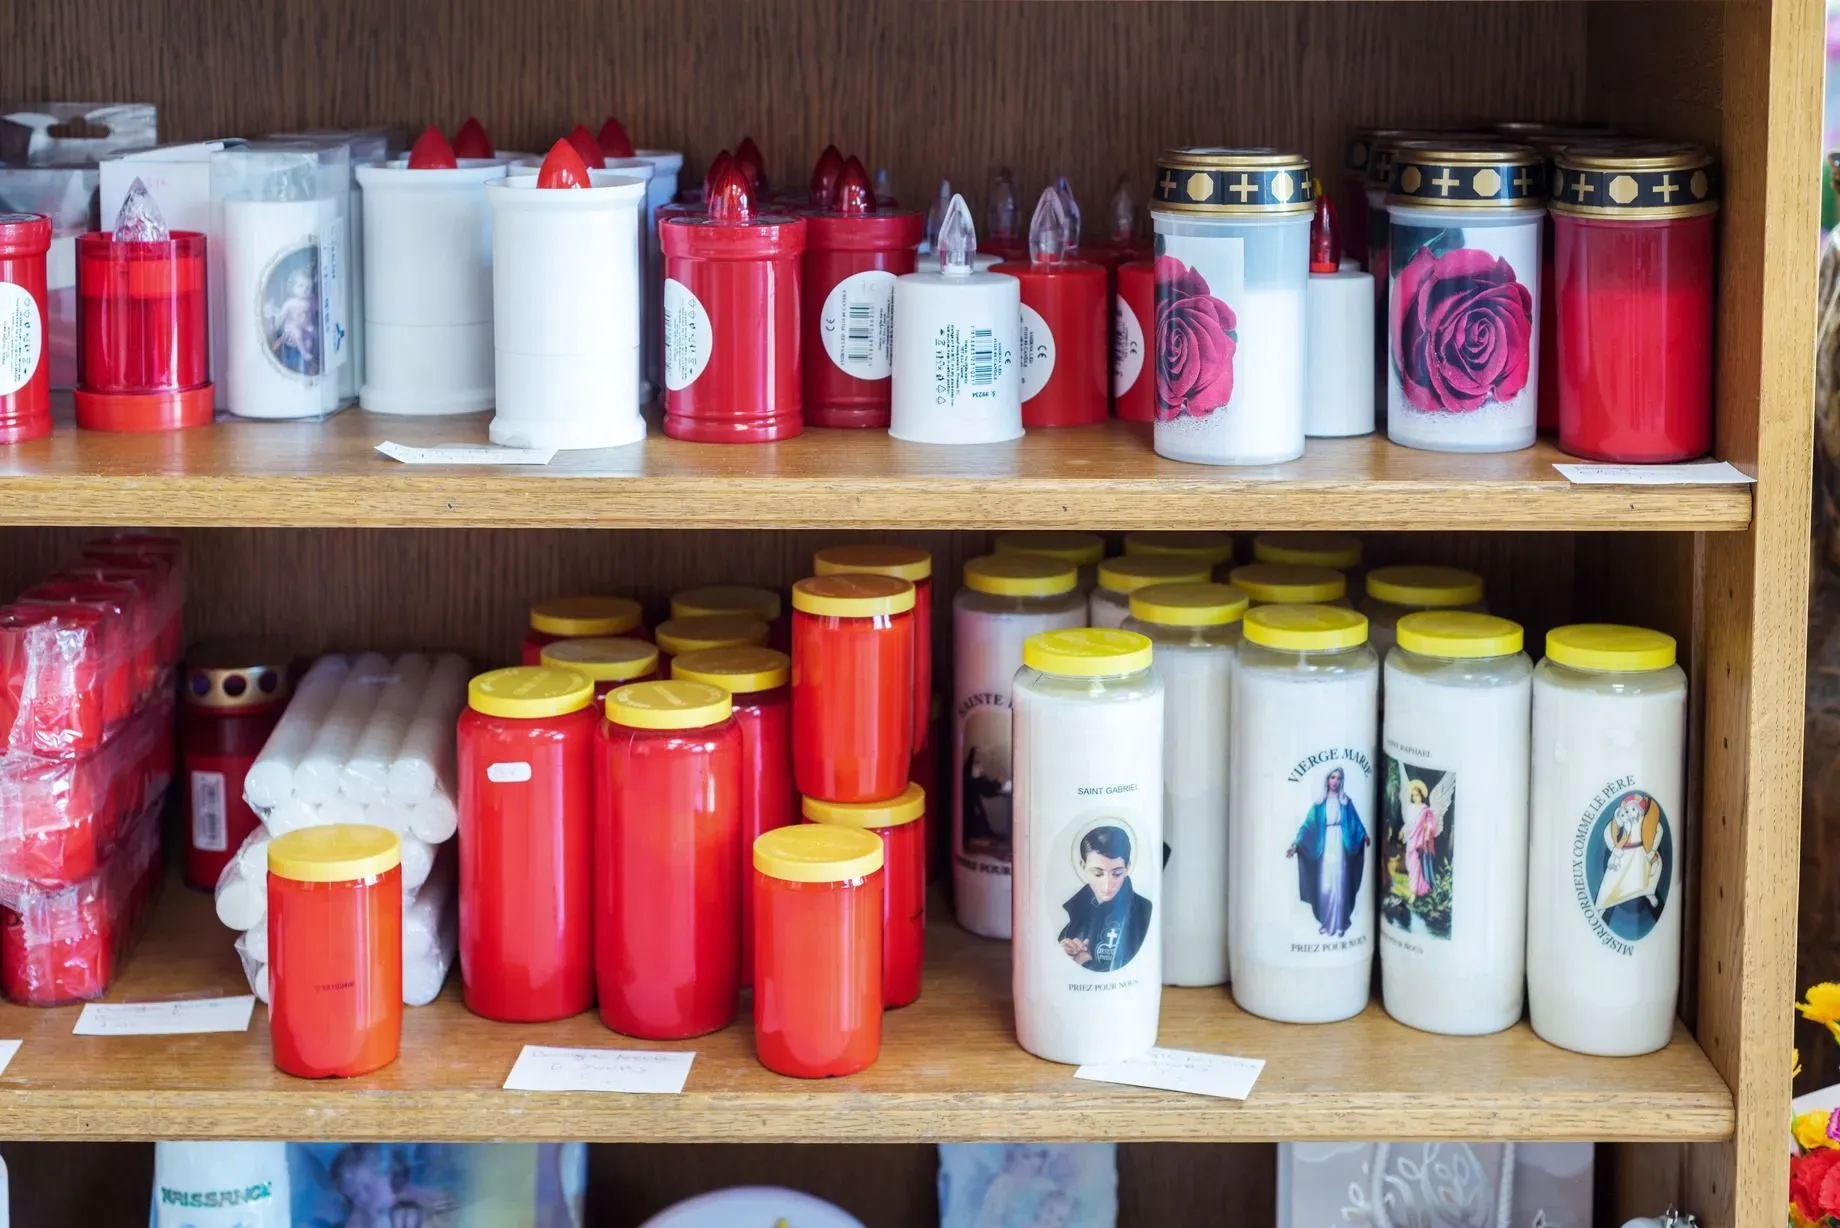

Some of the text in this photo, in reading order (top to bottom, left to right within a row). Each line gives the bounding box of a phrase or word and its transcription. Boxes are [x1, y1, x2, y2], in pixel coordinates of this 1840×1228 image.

[1287, 747, 1374, 783] VIERGE MARIE
[1077, 783, 1140, 796] SAINT GABRIEL
[1572, 774, 1637, 958] MISÉRICORDIEUX COMME LE PÈRE
[1290, 943, 1320, 953] PRIEZ
[1322, 942, 1348, 953] POUR
[1068, 983, 1094, 992] PRIEZ
[1094, 982, 1118, 992] POUR
